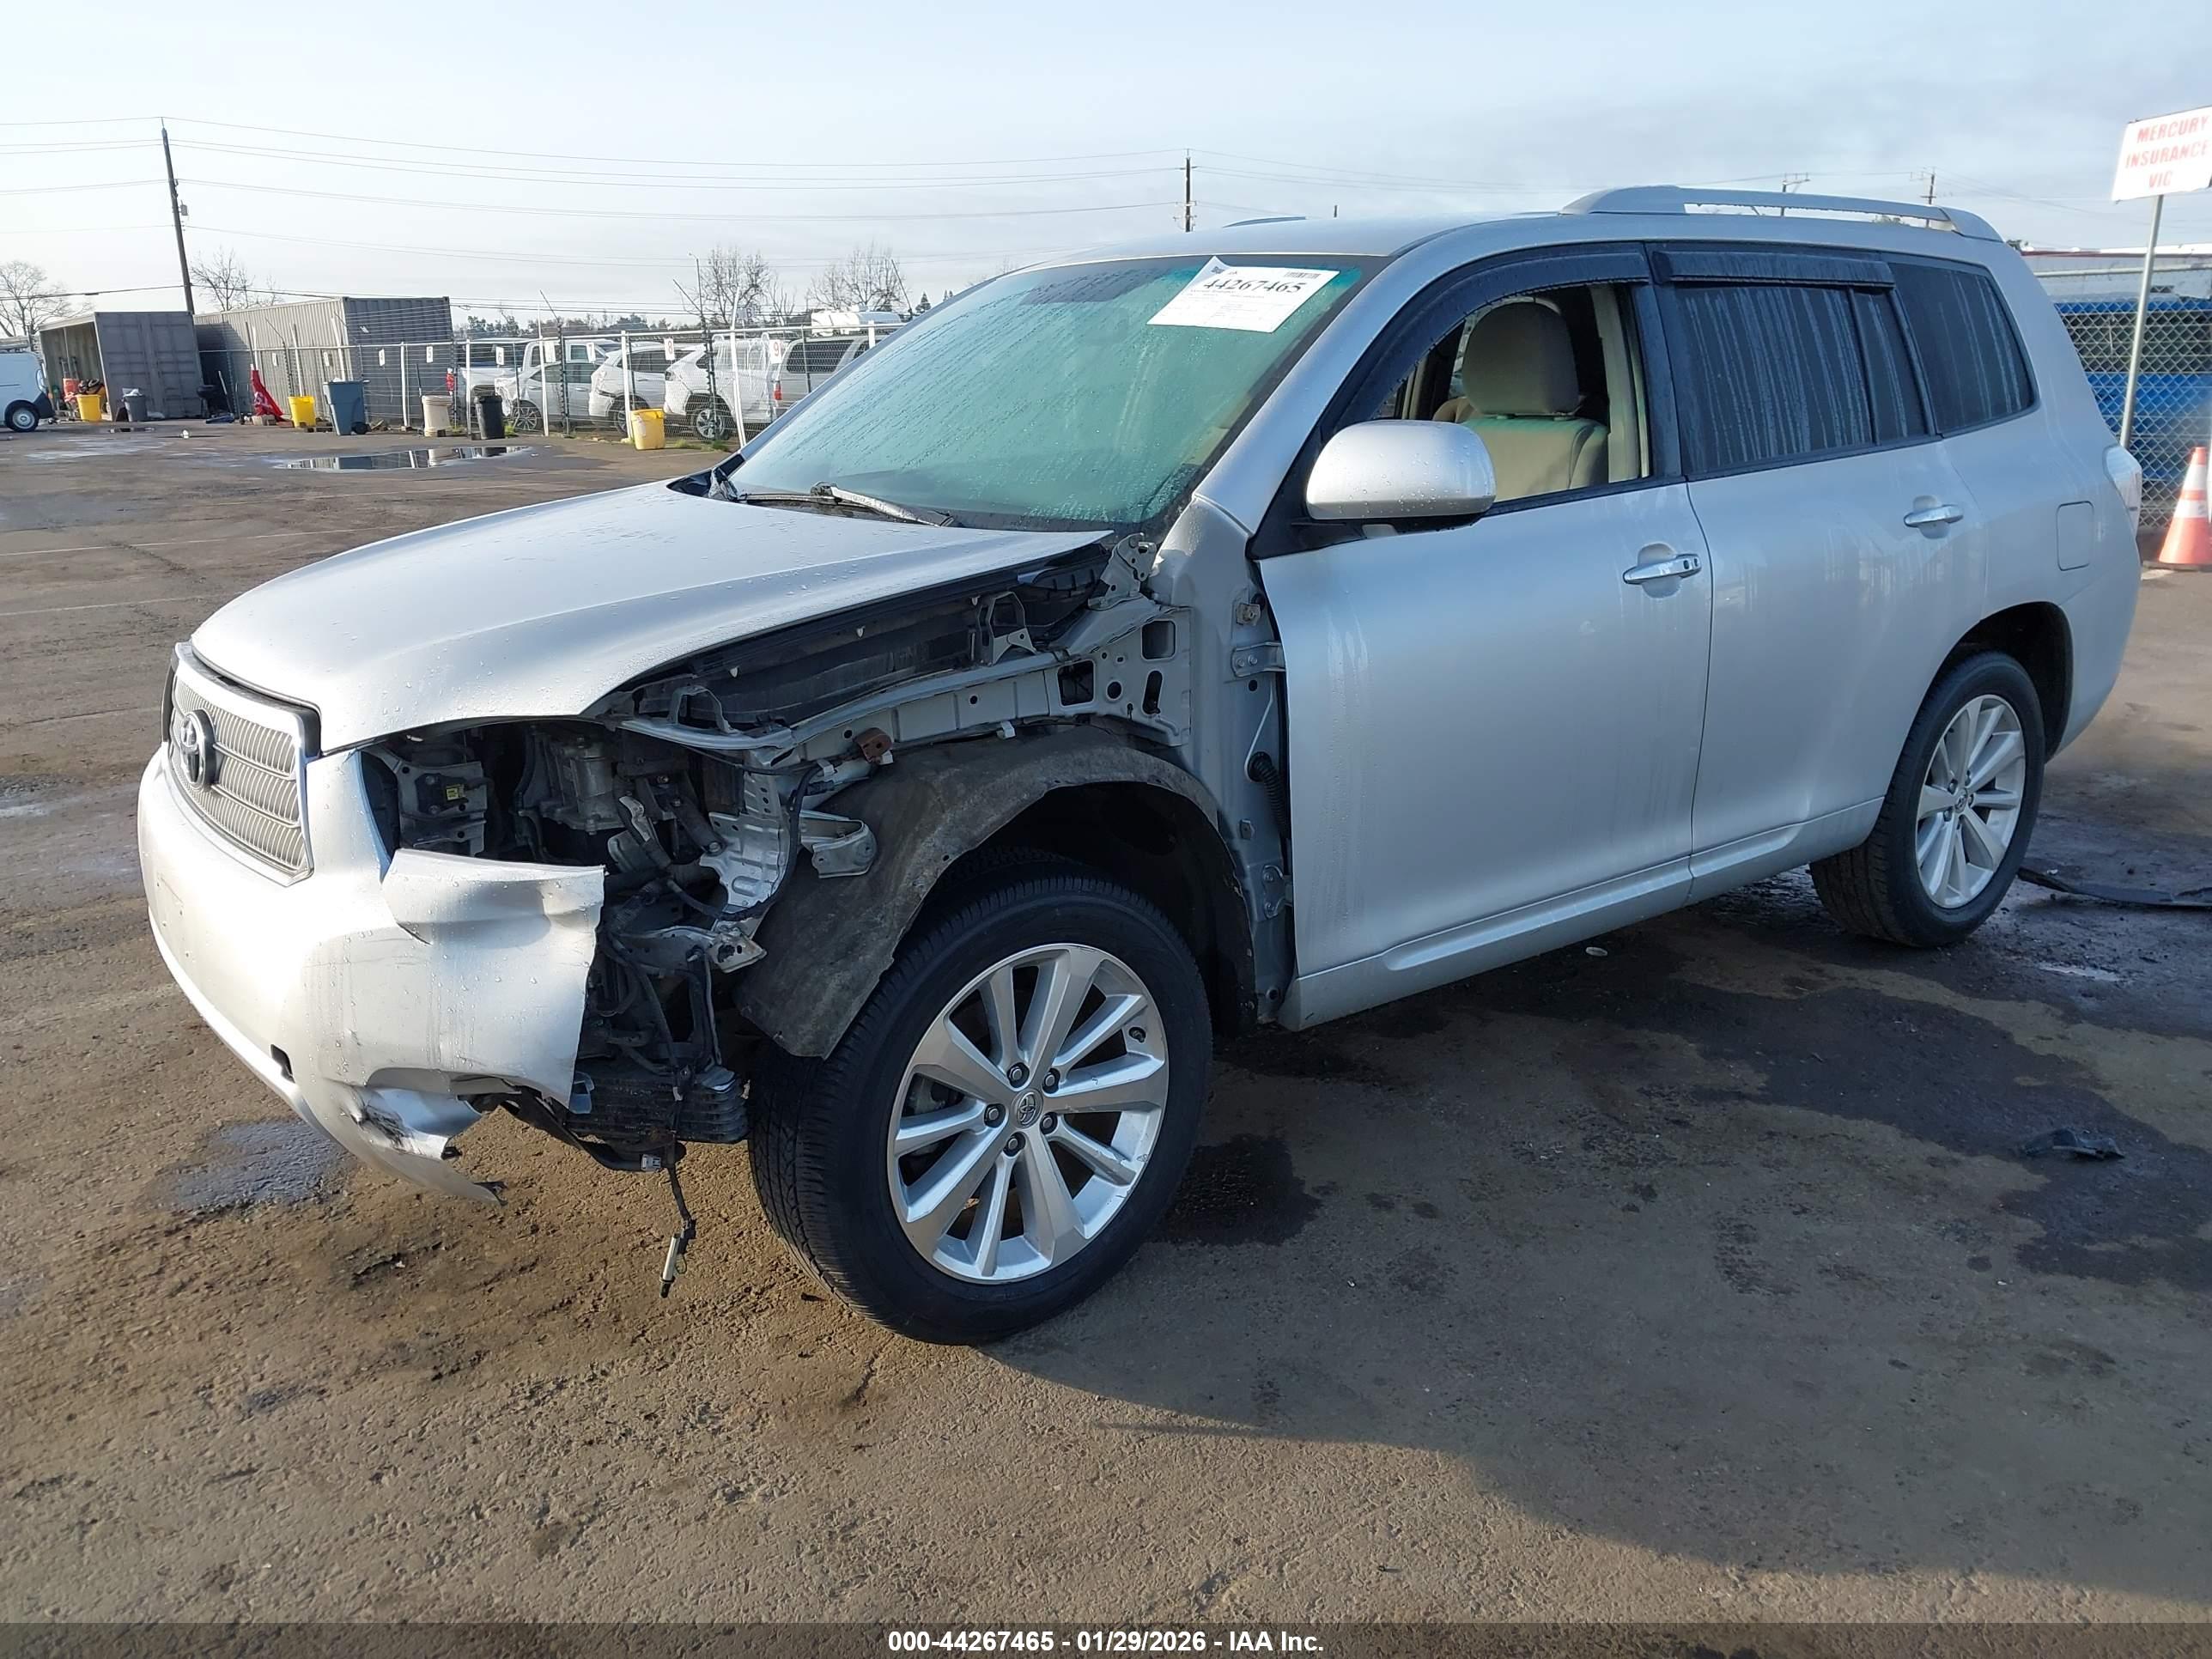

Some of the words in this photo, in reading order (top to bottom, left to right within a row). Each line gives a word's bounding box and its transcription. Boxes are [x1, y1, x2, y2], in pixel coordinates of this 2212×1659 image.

[2136, 115, 2209, 143] MERCURY
[2124, 138, 2209, 169] INSURANCE
[1203, 278, 1307, 293] 44267465
[667, 340, 673, 355] 8
[773, 341, 779, 356] 9
